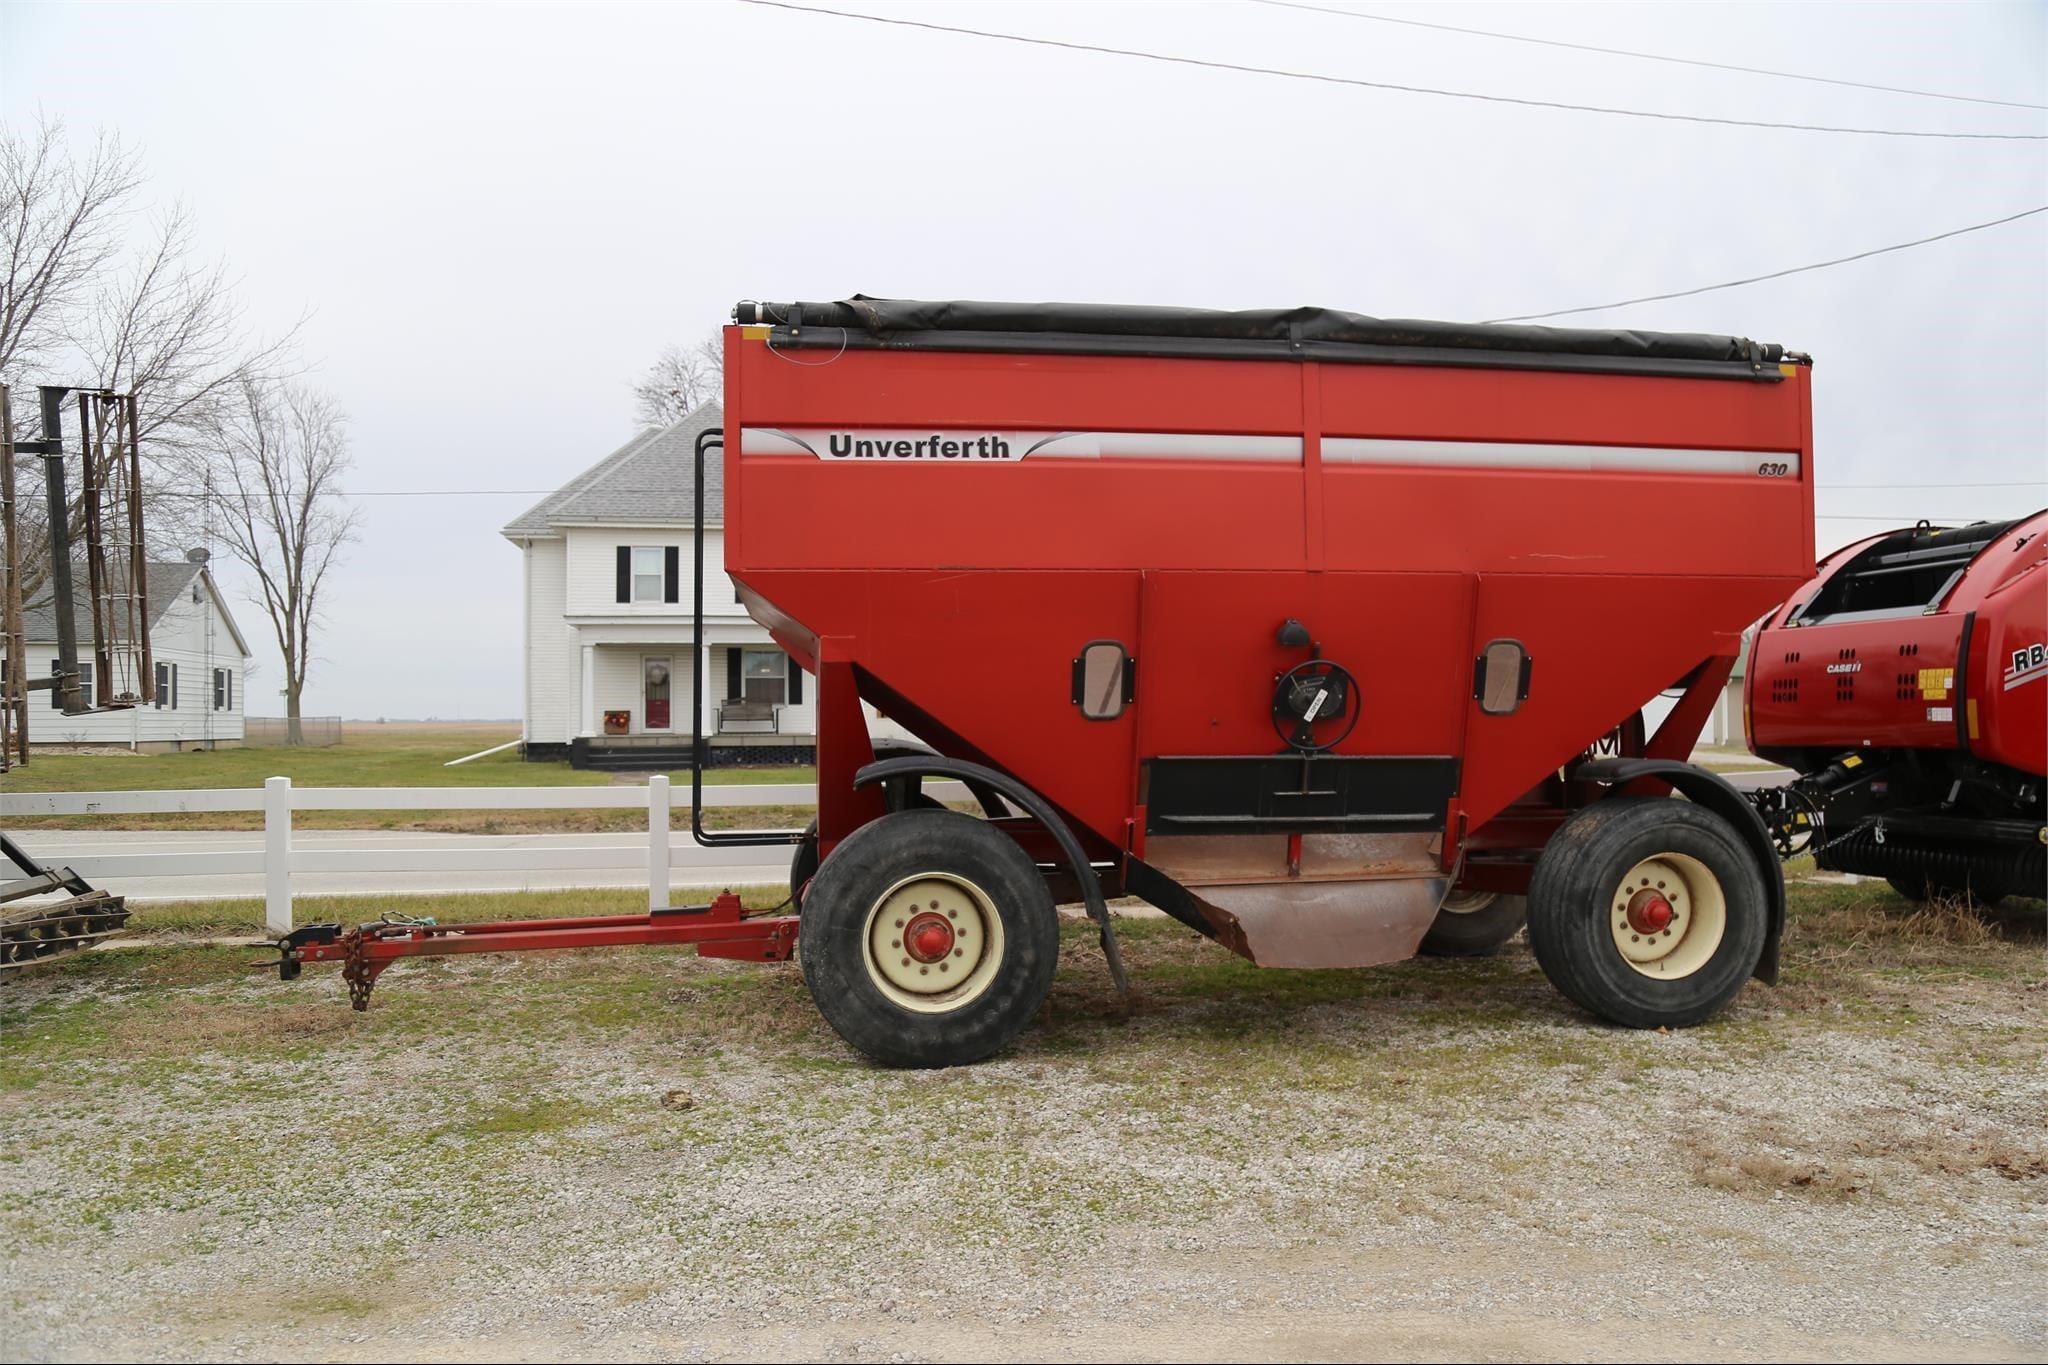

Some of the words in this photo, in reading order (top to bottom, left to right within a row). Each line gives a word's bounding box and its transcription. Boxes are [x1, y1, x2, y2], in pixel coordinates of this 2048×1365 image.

[829, 434, 1010, 459] Unverferth
[1758, 462, 1788, 476] 630
[2012, 644, 2048, 674] RB
